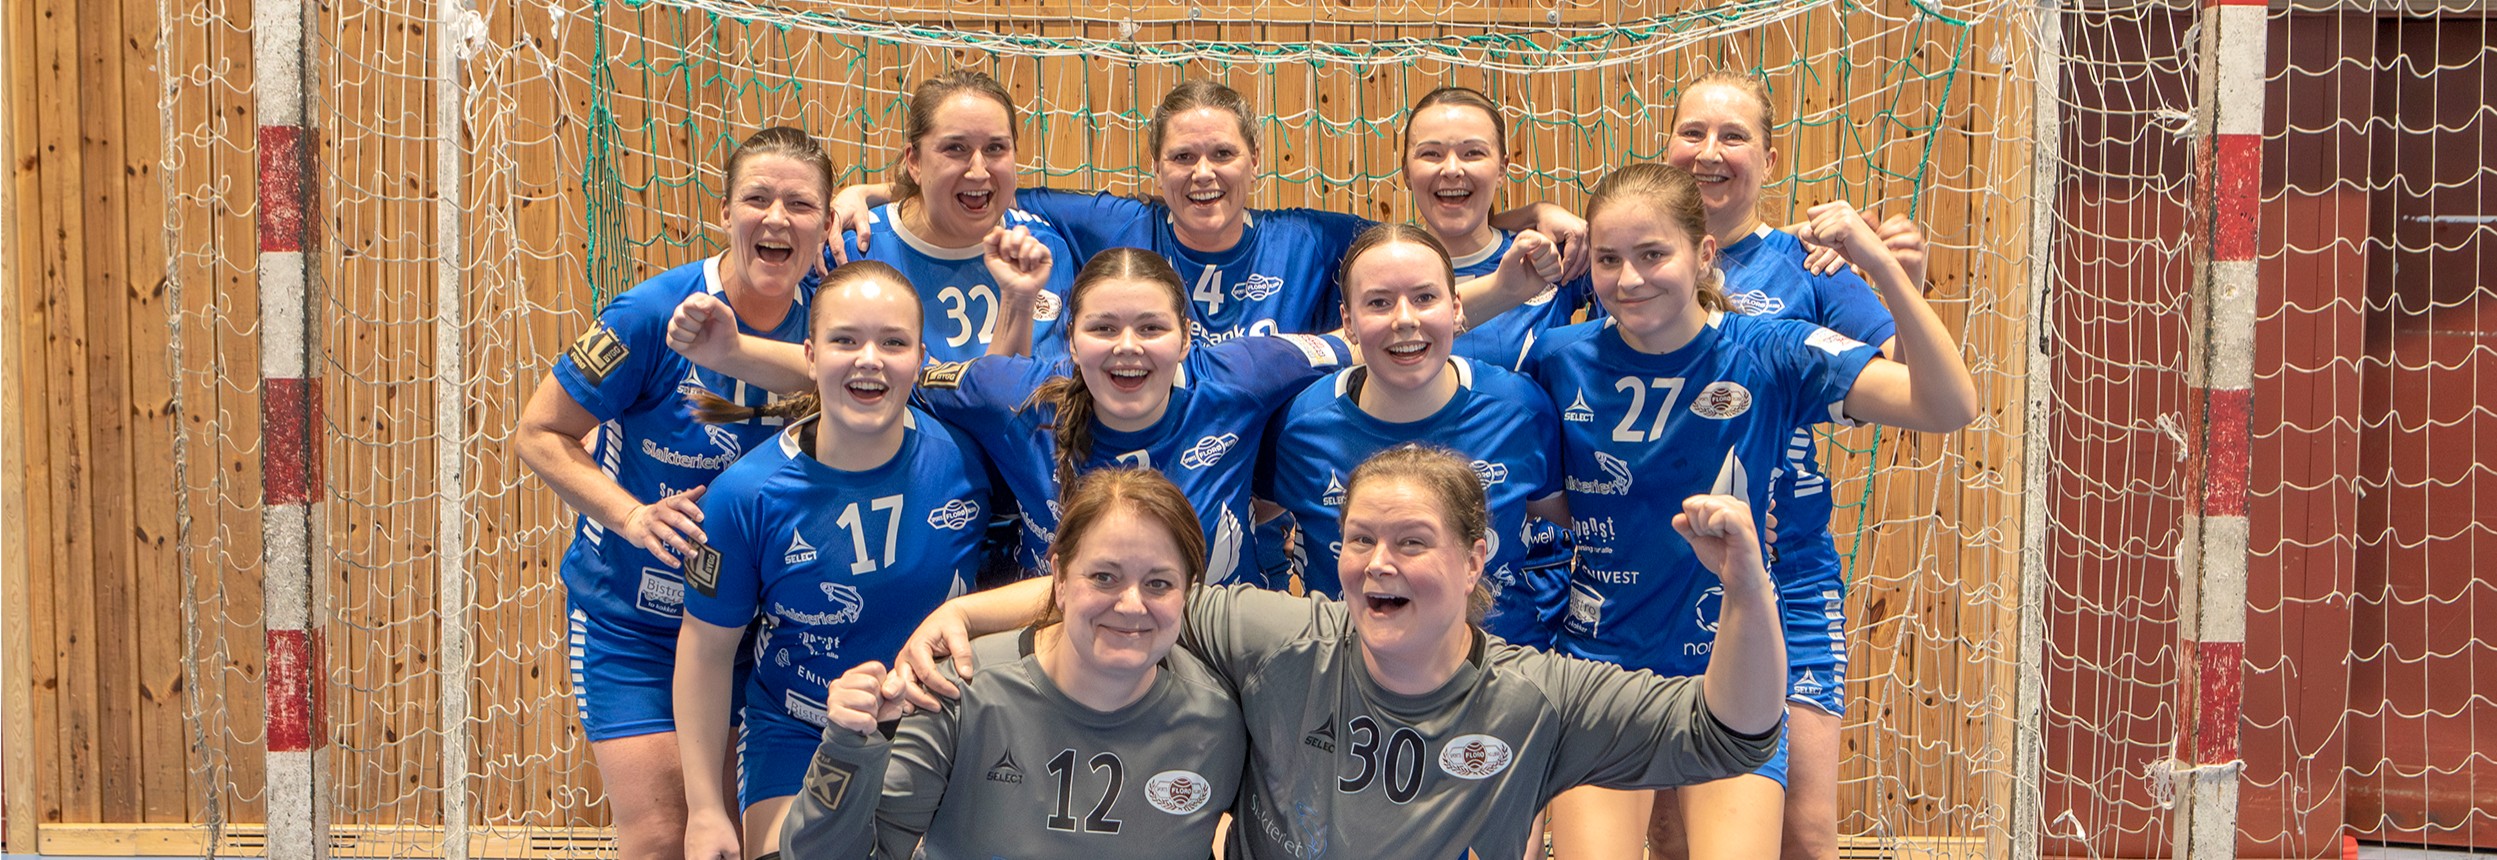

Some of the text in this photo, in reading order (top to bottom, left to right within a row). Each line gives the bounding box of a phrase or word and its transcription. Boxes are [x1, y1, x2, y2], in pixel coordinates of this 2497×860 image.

[1193, 264, 1224, 316] 4
[937, 284, 999, 348] 32
[602, 345, 621, 363] BYGG
[935, 373, 956, 381] BYGG
[1563, 412, 1595, 422] SELECT
[1612, 375, 1686, 443] 27
[642, 438, 721, 470] Slakteriet
[836, 494, 904, 576] 17
[1530, 525, 1555, 544] well
[704, 553, 716, 573] BYGG
[785, 551, 817, 565] SELECT
[797, 664, 831, 688] ENIV
[1793, 685, 1824, 696] SELECT
[1304, 735, 1336, 754] SELEC
[1337, 715, 1427, 805] 30
[986, 770, 1023, 785] SELECT
[1046, 748, 1122, 835] 12
